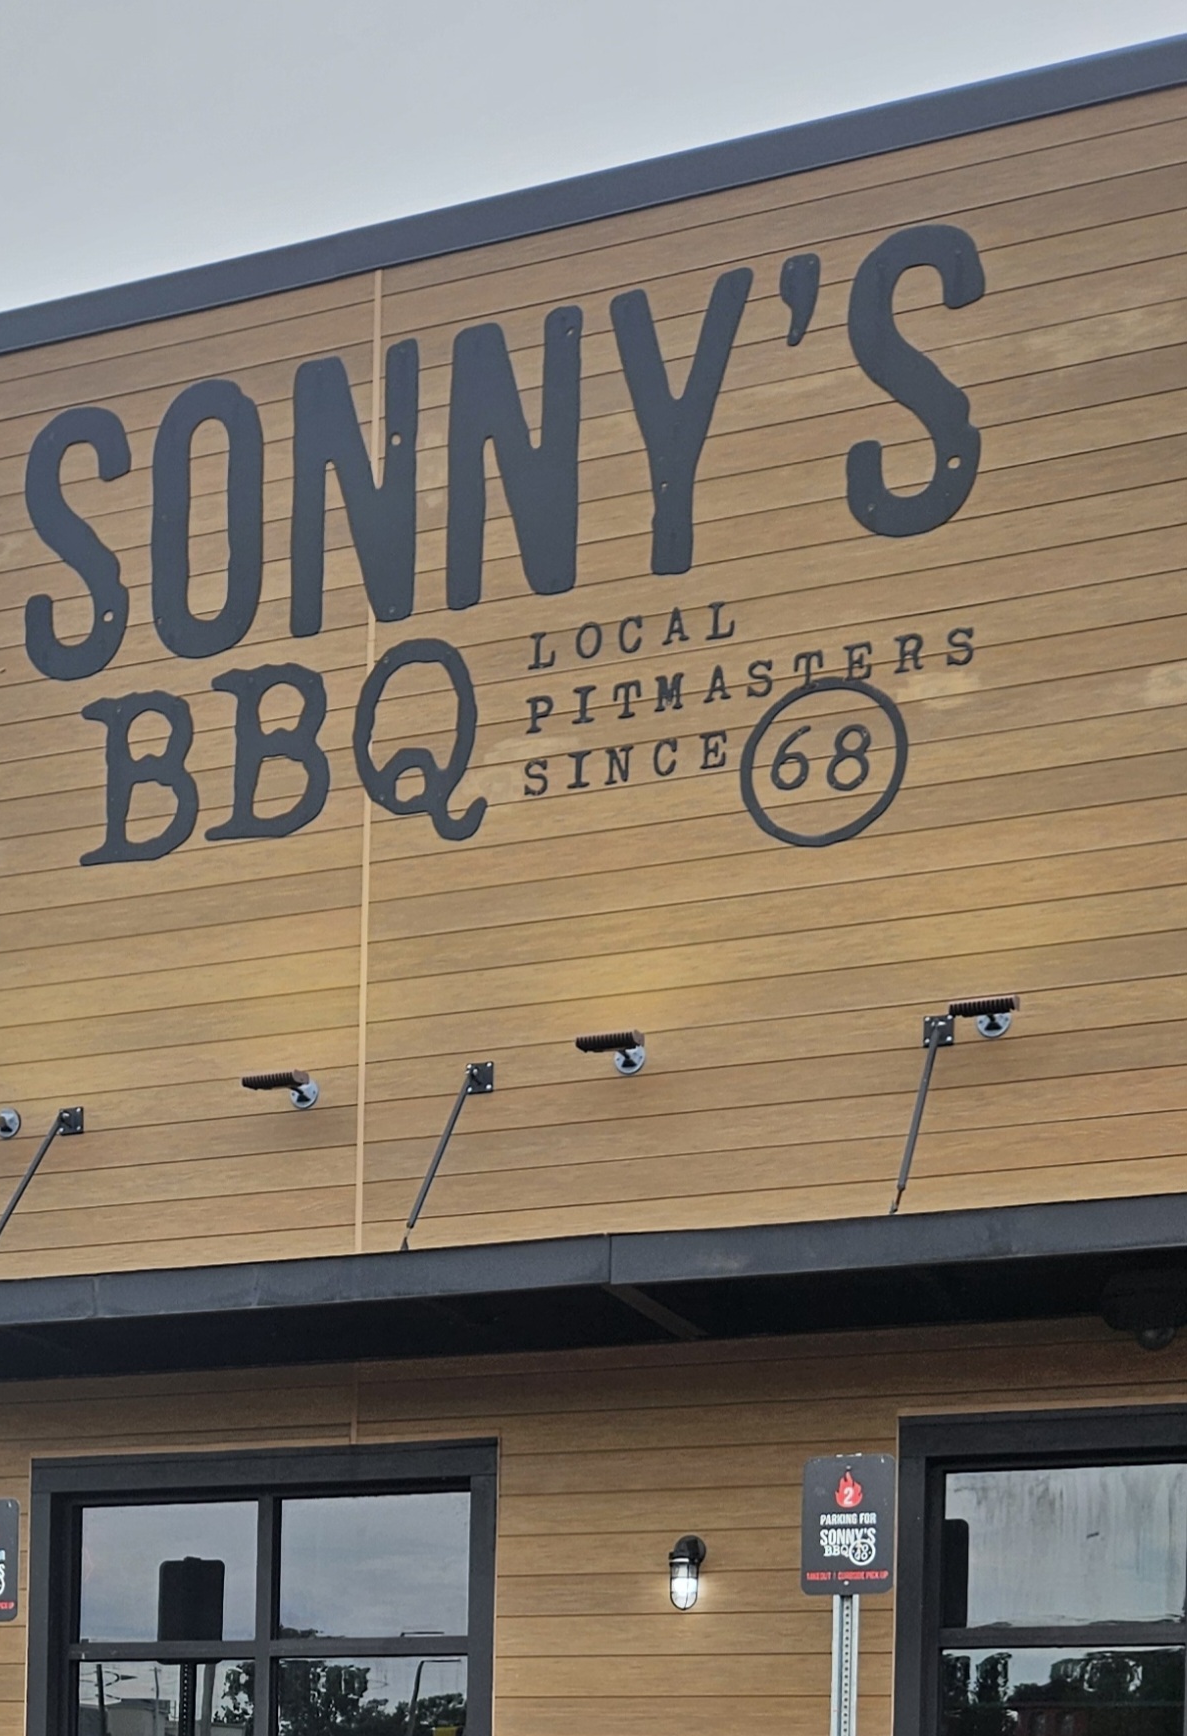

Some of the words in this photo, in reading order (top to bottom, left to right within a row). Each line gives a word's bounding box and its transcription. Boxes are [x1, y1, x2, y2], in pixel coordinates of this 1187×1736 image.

[24, 224, 986, 682] SONNY'S
[527, 602, 736, 671] LOCAL
[525, 627, 976, 734] PITMASTERS
[80, 637, 487, 866] BBQ
[523, 730, 729, 796] SINCE
[770, 723, 872, 792] 68
[820, 1513, 857, 1526] PARKING
[859, 1512, 877, 1525] FOR
[843, 1487, 854, 1505] 2
[820, 1527, 877, 1547] SONNY'S
[823, 1545, 850, 1558] BBQ
